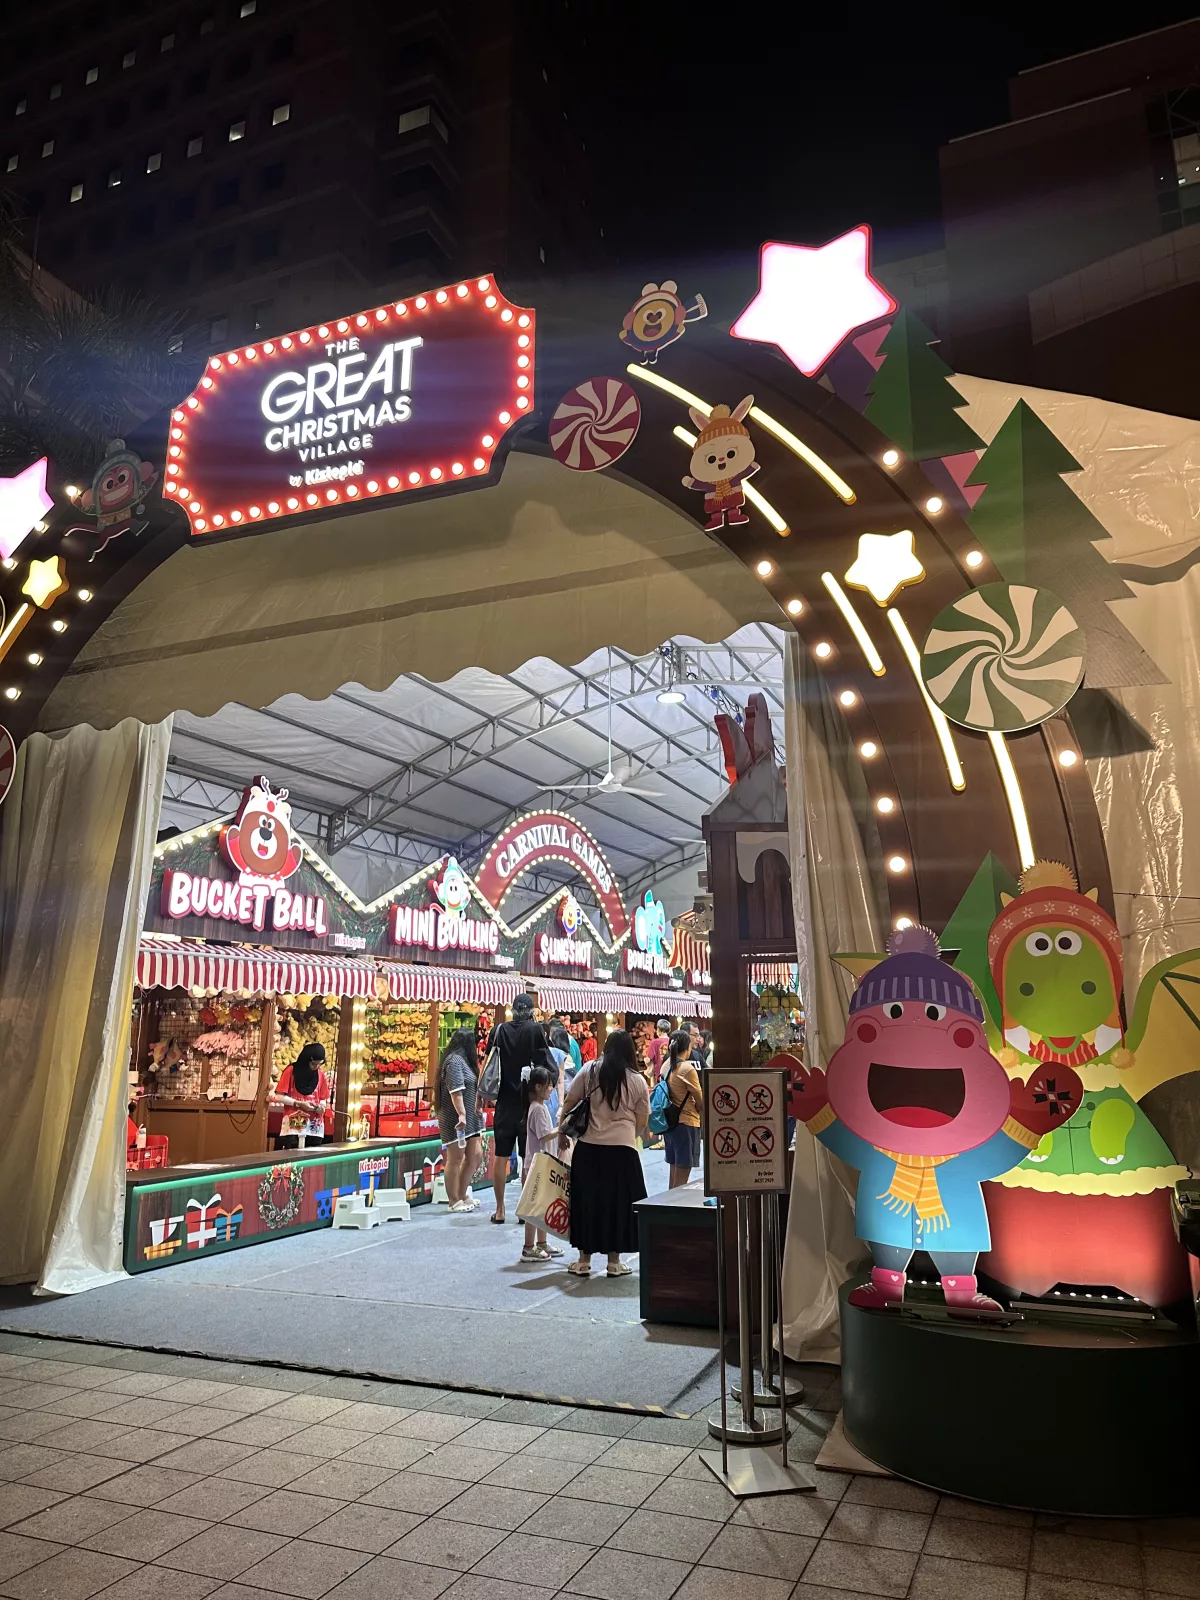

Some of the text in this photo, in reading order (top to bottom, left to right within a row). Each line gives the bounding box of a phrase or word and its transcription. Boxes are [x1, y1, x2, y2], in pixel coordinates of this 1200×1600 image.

[325, 337, 360, 357] THE
[261, 336, 424, 423] GREAT
[264, 396, 412, 451] CHRISTMAS
[299, 434, 373, 462] VILLAGE
[496, 824, 612, 894] CARNIVAL GAMES
[168, 872, 327, 937] BUCKET BALL
[395, 906, 499, 953] MINI BOWLING
[359, 1157, 389, 1173] Kiztopia
